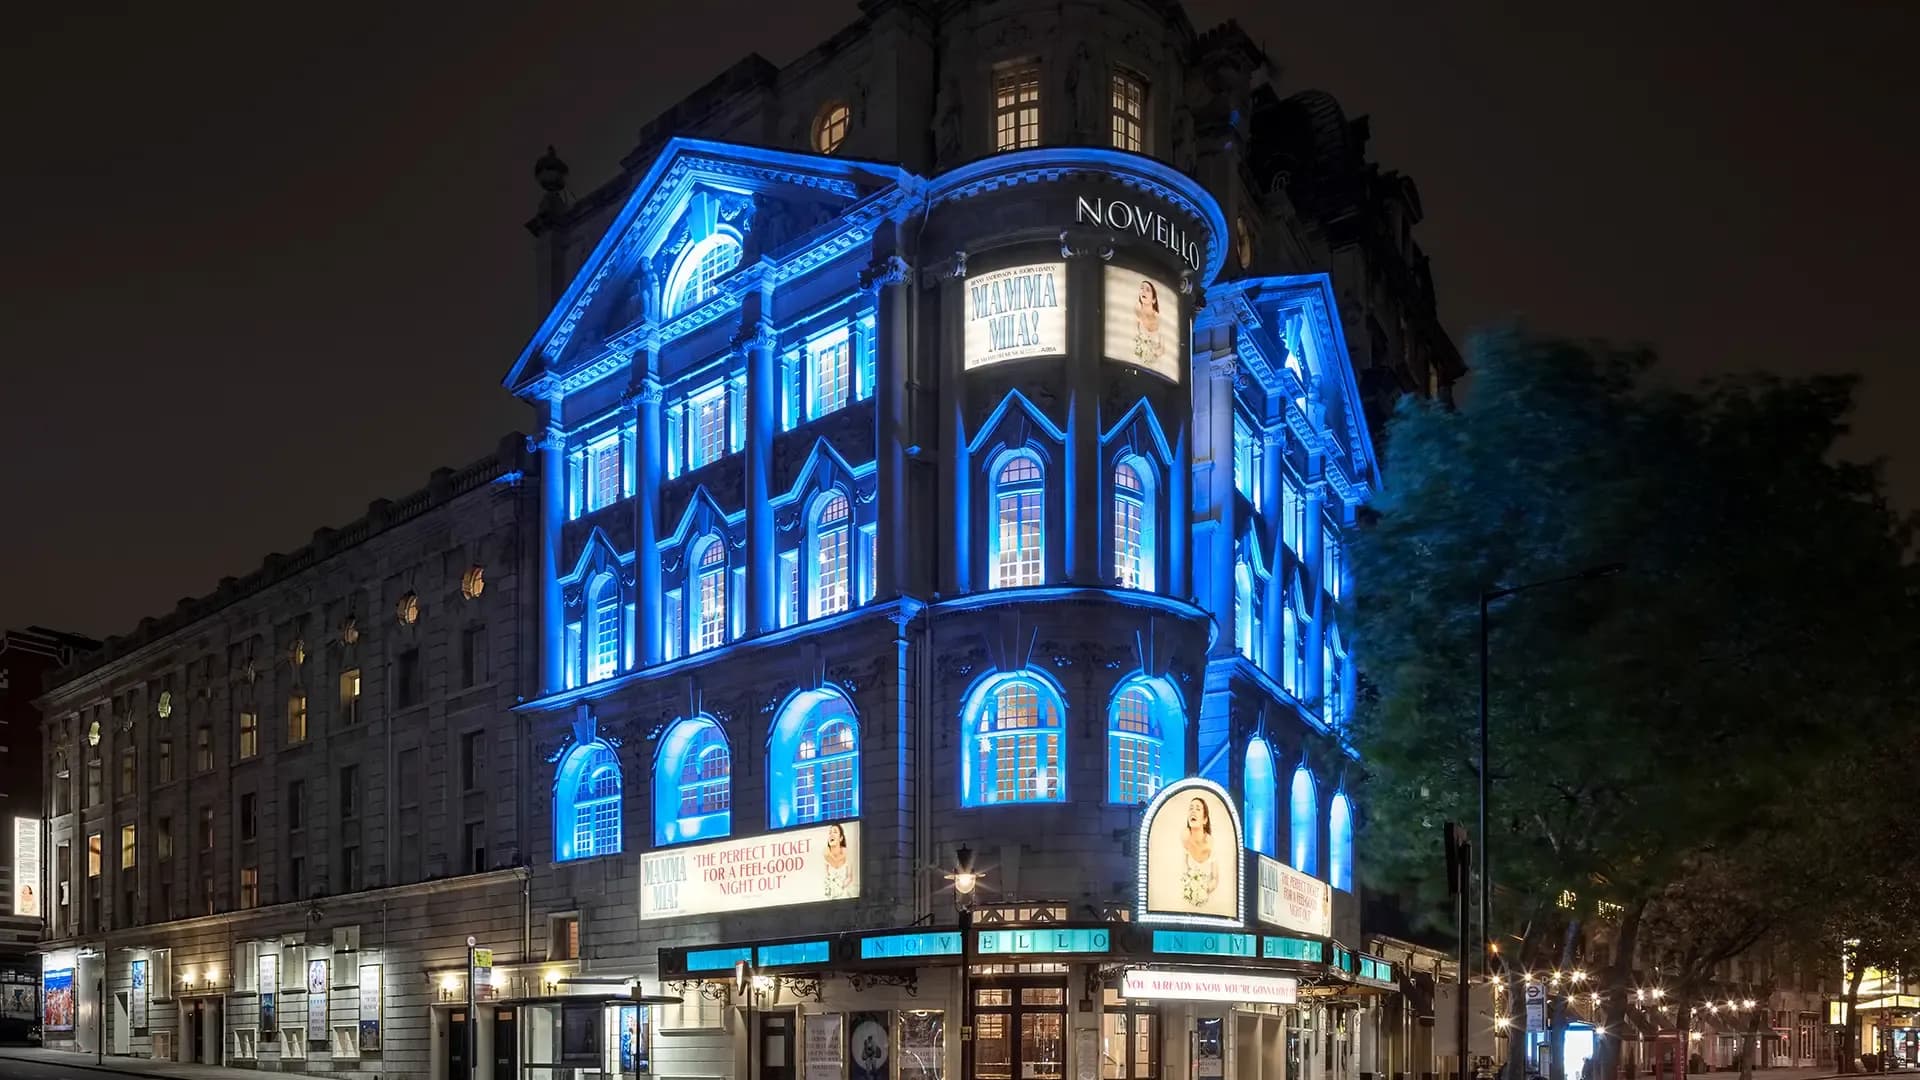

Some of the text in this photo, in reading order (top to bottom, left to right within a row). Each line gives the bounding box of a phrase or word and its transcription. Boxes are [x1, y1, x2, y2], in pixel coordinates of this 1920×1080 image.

[1076, 194, 1200, 272] NOVELLO
[971, 272, 1058, 321] MAMMA
[988, 310, 1040, 352] MIA!
[720, 845, 766, 865] PERFECT
[770, 838, 812, 858] TICKET
[703, 866, 726, 882] FOR
[728, 865, 736, 879] A
[719, 877, 753, 897] NIGHT
[1151, 980, 1194, 992] ALREADY
[1195, 981, 1221, 993] KNOW
